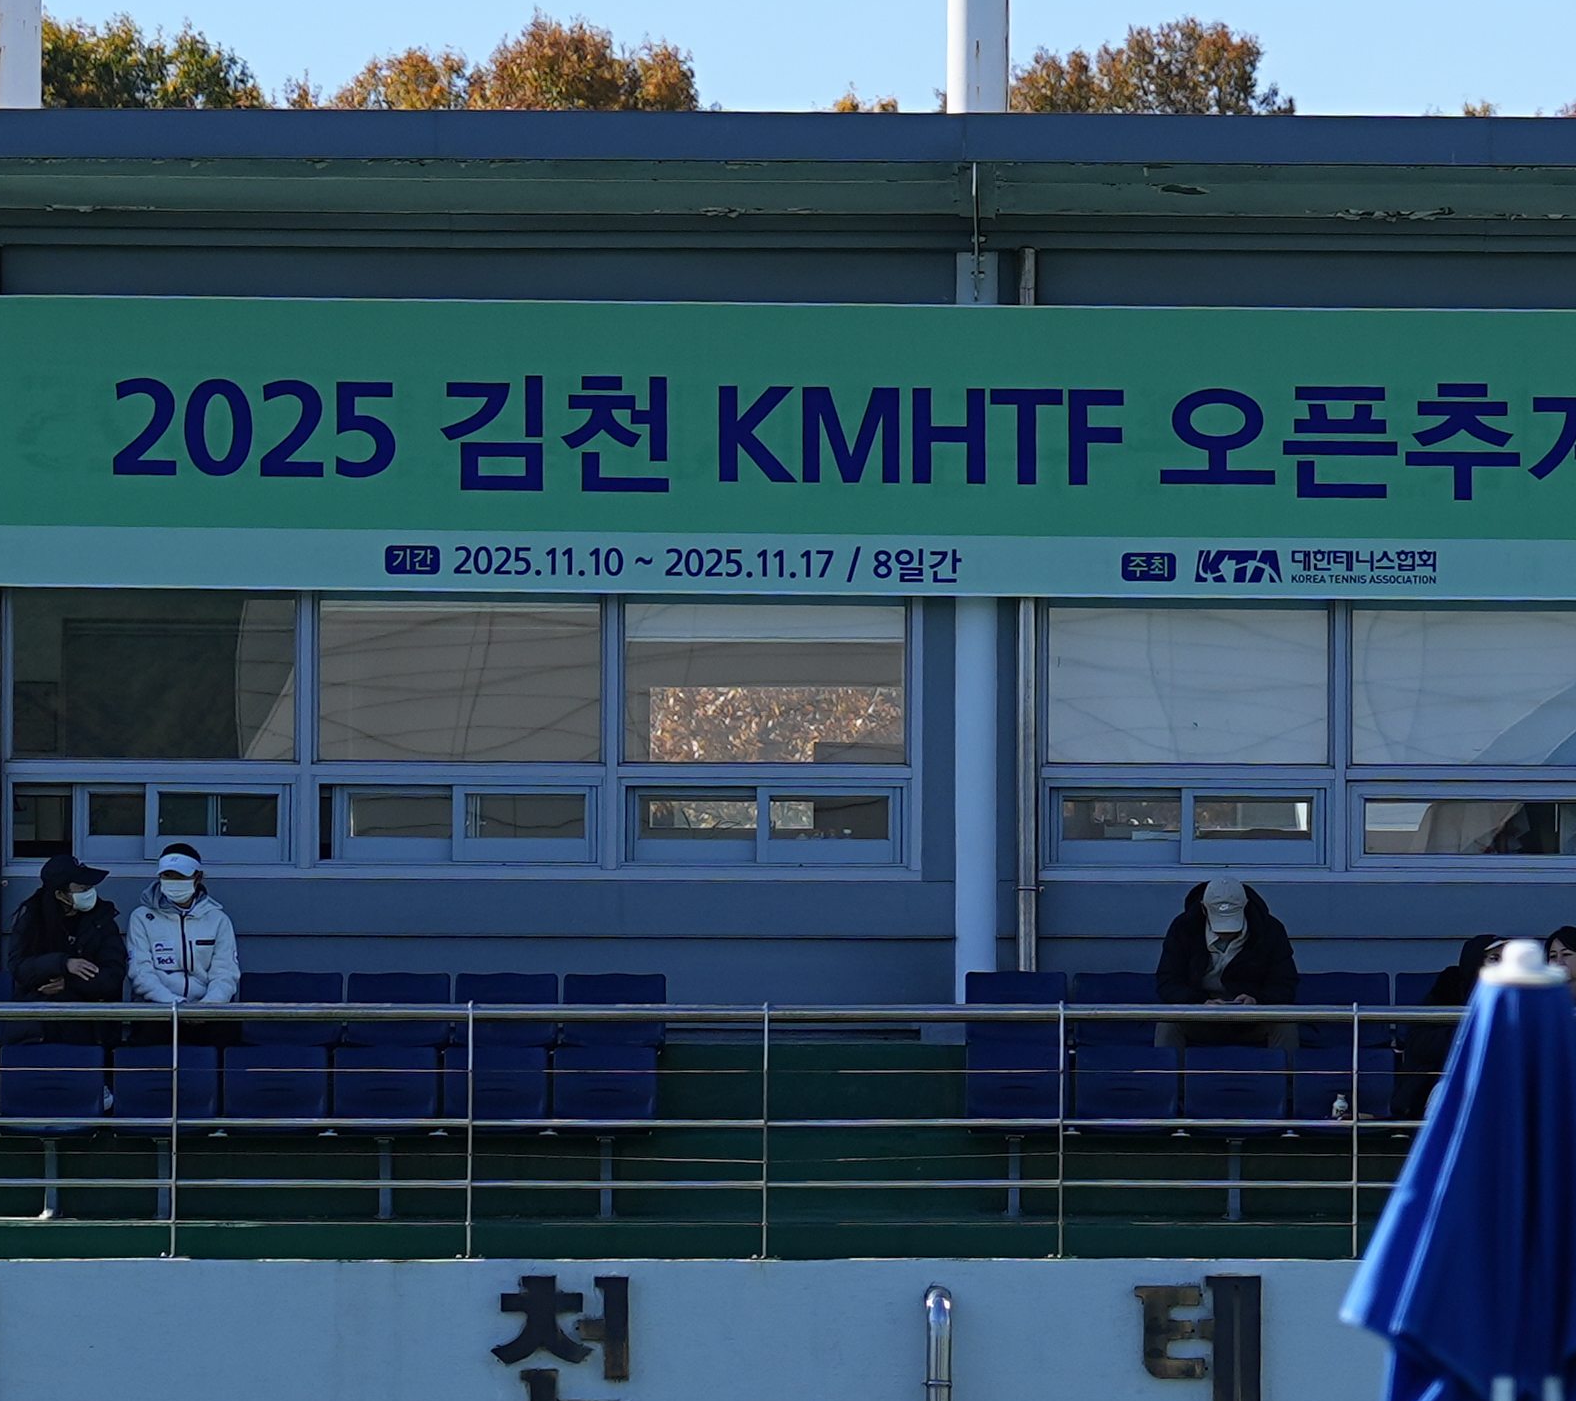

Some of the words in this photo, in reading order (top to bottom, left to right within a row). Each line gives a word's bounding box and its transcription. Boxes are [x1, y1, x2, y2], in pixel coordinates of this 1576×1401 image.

[114, 379, 396, 479] 2025
[442, 376, 670, 493] 김천
[720, 387, 1125, 486] KMHTF
[392, 549, 433, 571] 기간
[454, 547, 624, 577] 2025.11.10
[665, 549, 835, 579] 2025.11.17
[848, 547, 862, 584] /
[873, 549, 964, 584] 8일간
[1127, 556, 1169, 578] 주최
[1195, 550, 1283, 584] KTA
[1291, 549, 1438, 573] 대한테니스협회
[1291, 575, 1327, 585] KOREA
[1329, 575, 1367, 585] TENNIS
[1369, 575, 1438, 585] ASSOCIATION
